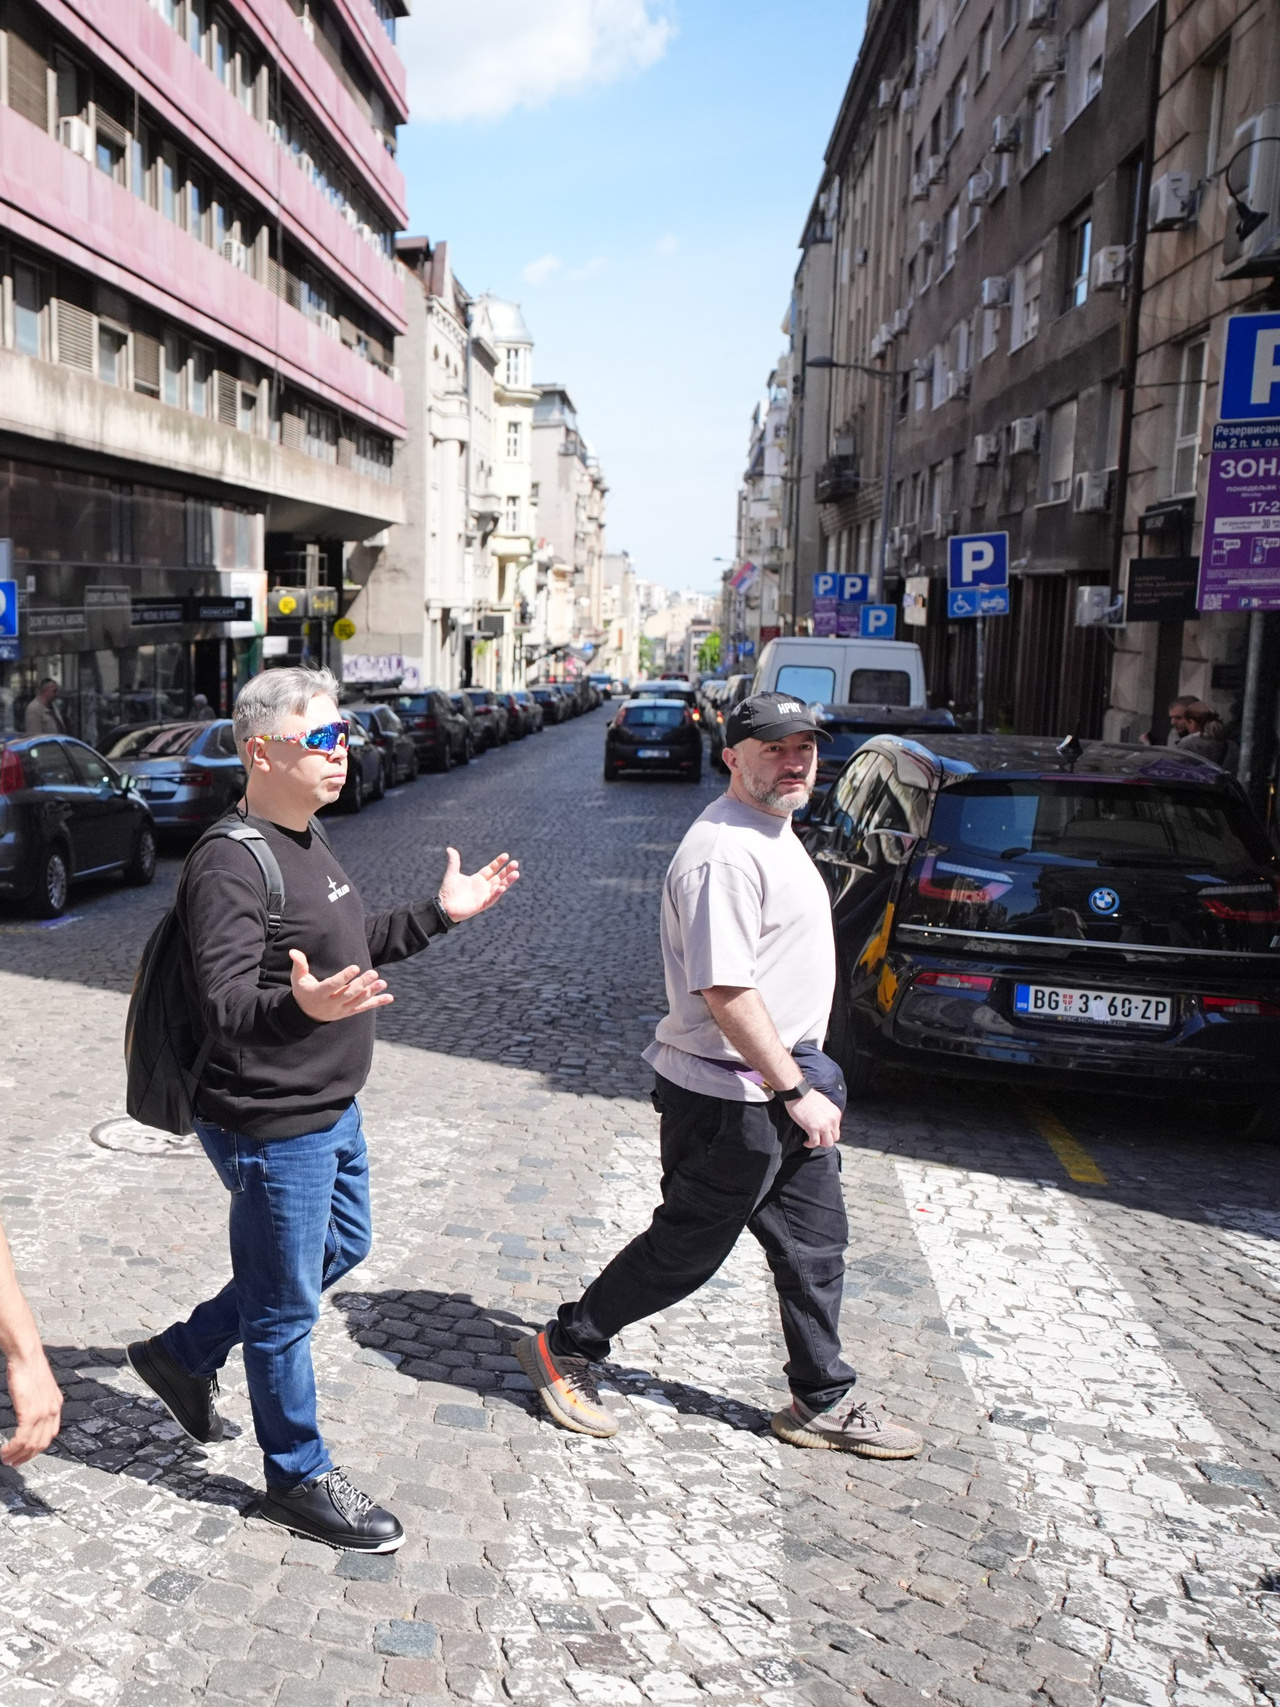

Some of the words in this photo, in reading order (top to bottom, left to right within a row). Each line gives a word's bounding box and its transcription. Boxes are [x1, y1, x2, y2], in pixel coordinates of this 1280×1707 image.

[1216, 425, 1280, 437] Резервисан
[1214, 440, 1227, 449] на
[1230, 438, 1237, 449] 2
[1220, 458, 1280, 479] ЗОН
[1249, 501, 1280, 513] 17-2
[962, 541, 994, 582] P
[818, 575, 833, 595] P
[844, 576, 862, 599] P
[868, 609, 887, 633] P
[1034, 989, 1060, 1010] BG
[1078, 993, 1167, 1021] 360-ZP
